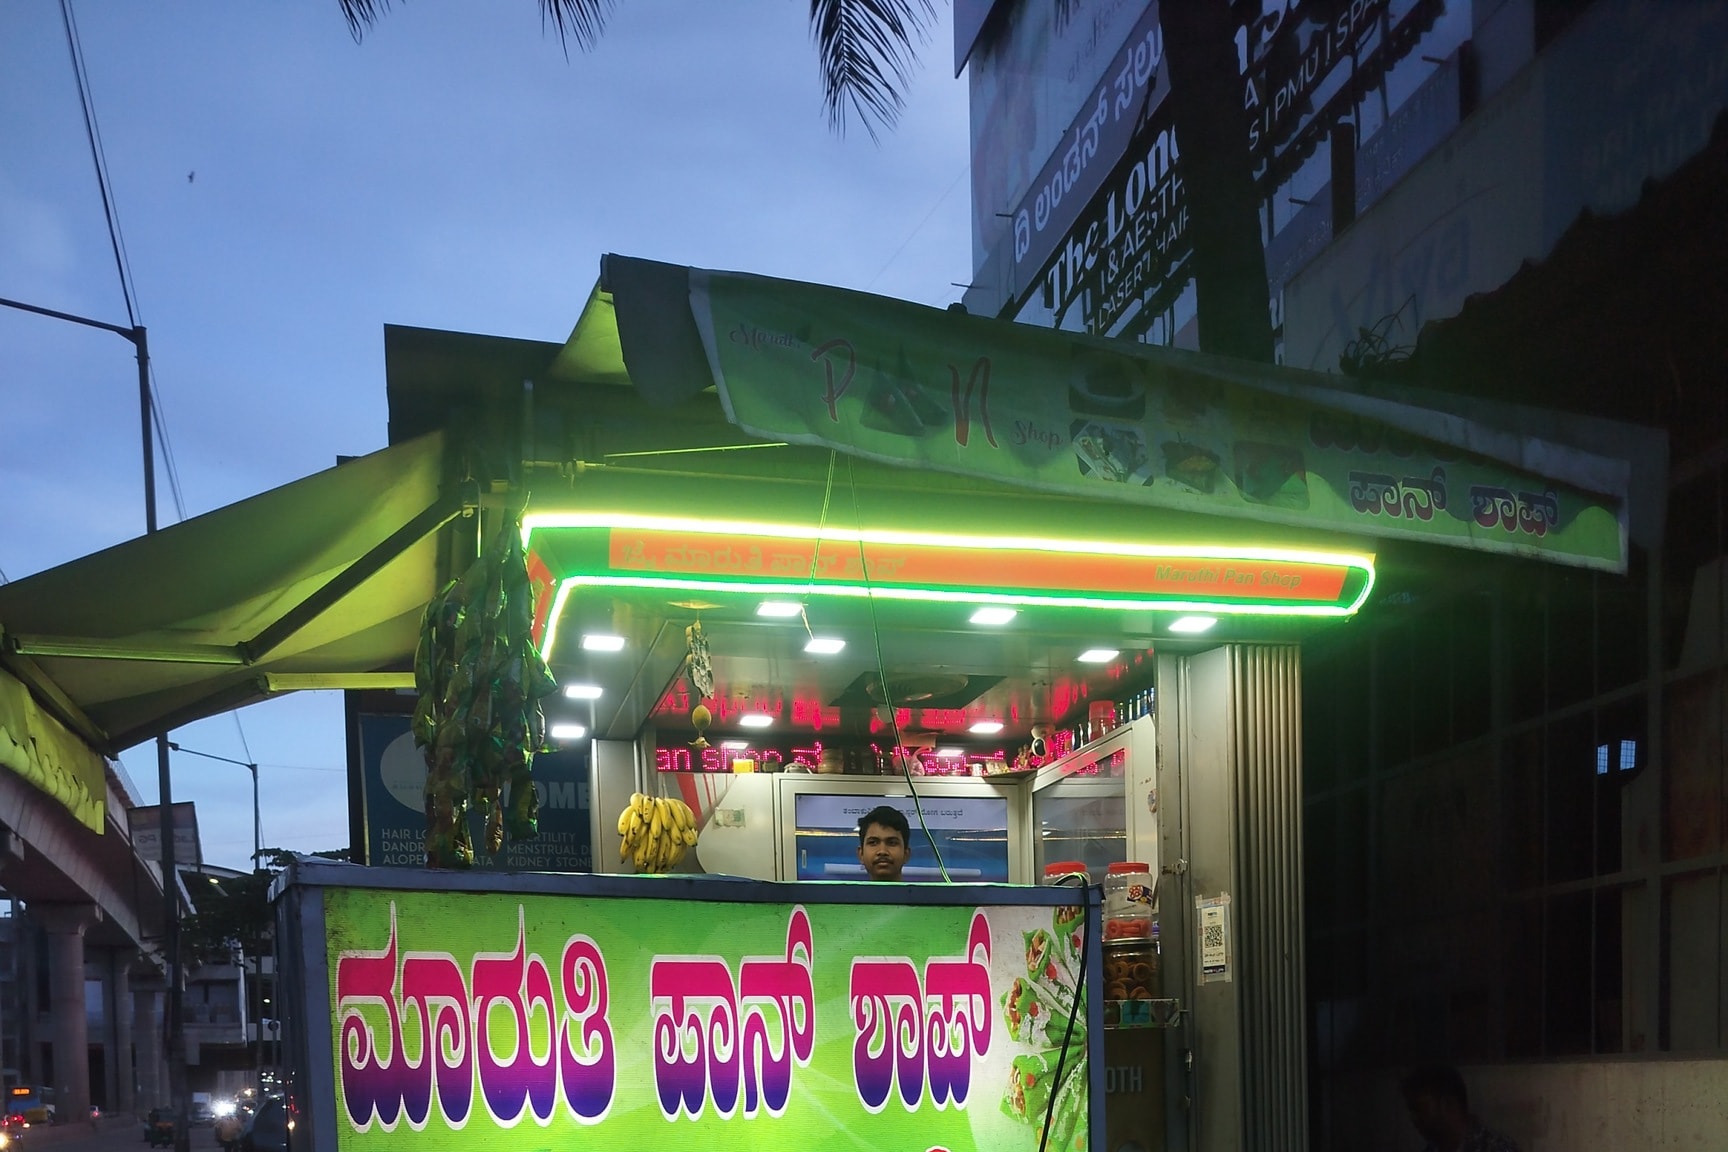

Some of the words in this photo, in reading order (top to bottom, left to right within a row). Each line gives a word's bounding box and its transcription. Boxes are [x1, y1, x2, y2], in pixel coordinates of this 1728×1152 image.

[1273, 44, 1320, 122] PMU
[1034, 85, 1109, 232] ಲಂಡನ್
[1047, 219, 1099, 315] The
[1009, 419, 1064, 452] Shop
[1346, 465, 1448, 522] ಪಾನ್
[1469, 484, 1560, 539] ಶಾಪ್
[1154, 564, 1219, 585] Maruthi
[1222, 568, 1255, 586] Pan
[1259, 570, 1302, 589] Shop
[381, 828, 411, 840] HAIR
[382, 840, 425, 852] DANDR
[382, 853, 425, 866] ALOPE
[506, 843, 578, 855] MENSTRUAL
[506, 856, 552, 867] KIDNEY
[556, 856, 593, 868] STONE
[336, 901, 616, 1134] ಮಾರುತಿ
[650, 903, 816, 1123] ಪಾನ್
[850, 906, 993, 1115] ಶಾಪ್
[1104, 1065, 1143, 1093] OTH
